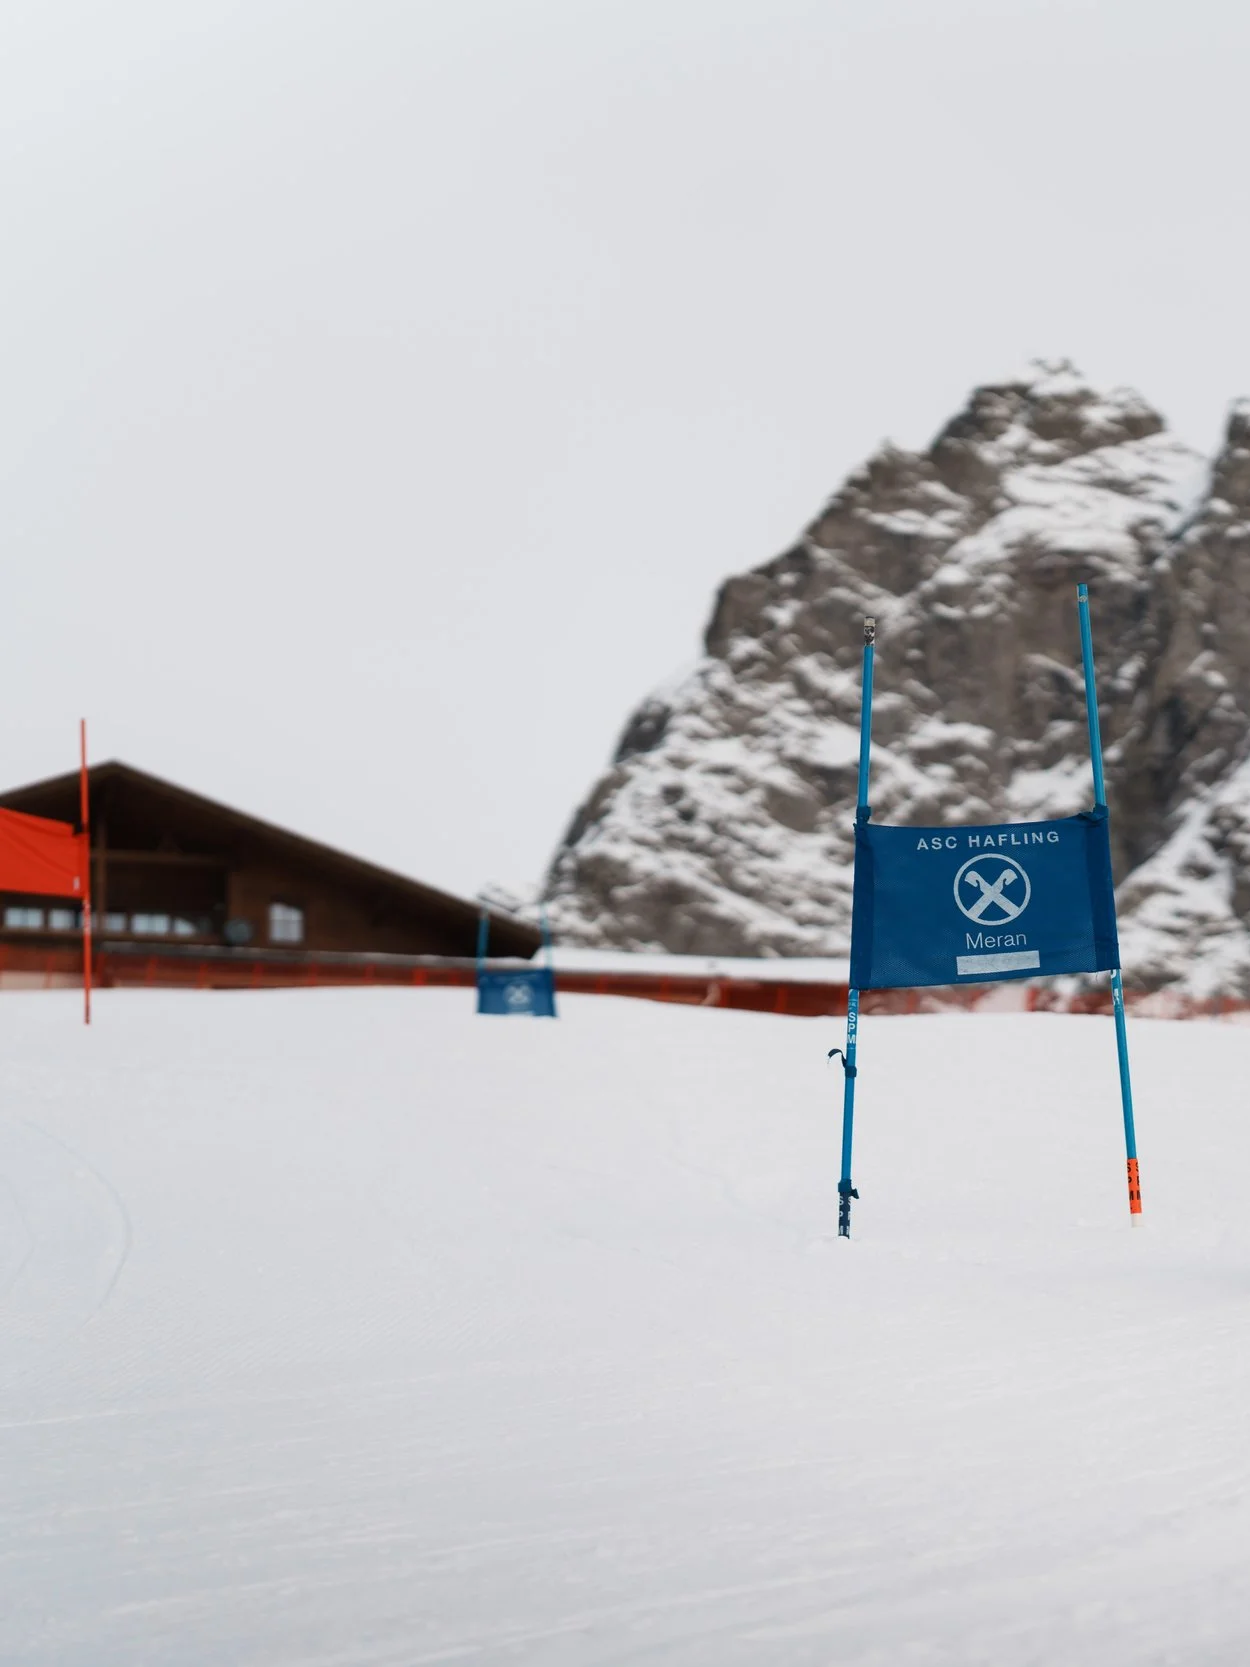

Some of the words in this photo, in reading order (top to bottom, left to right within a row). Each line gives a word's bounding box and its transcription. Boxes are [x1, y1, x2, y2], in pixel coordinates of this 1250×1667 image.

[917, 836, 957, 850] ASC
[968, 831, 1060, 848] HAFLING
[965, 932, 1027, 950] Meran
